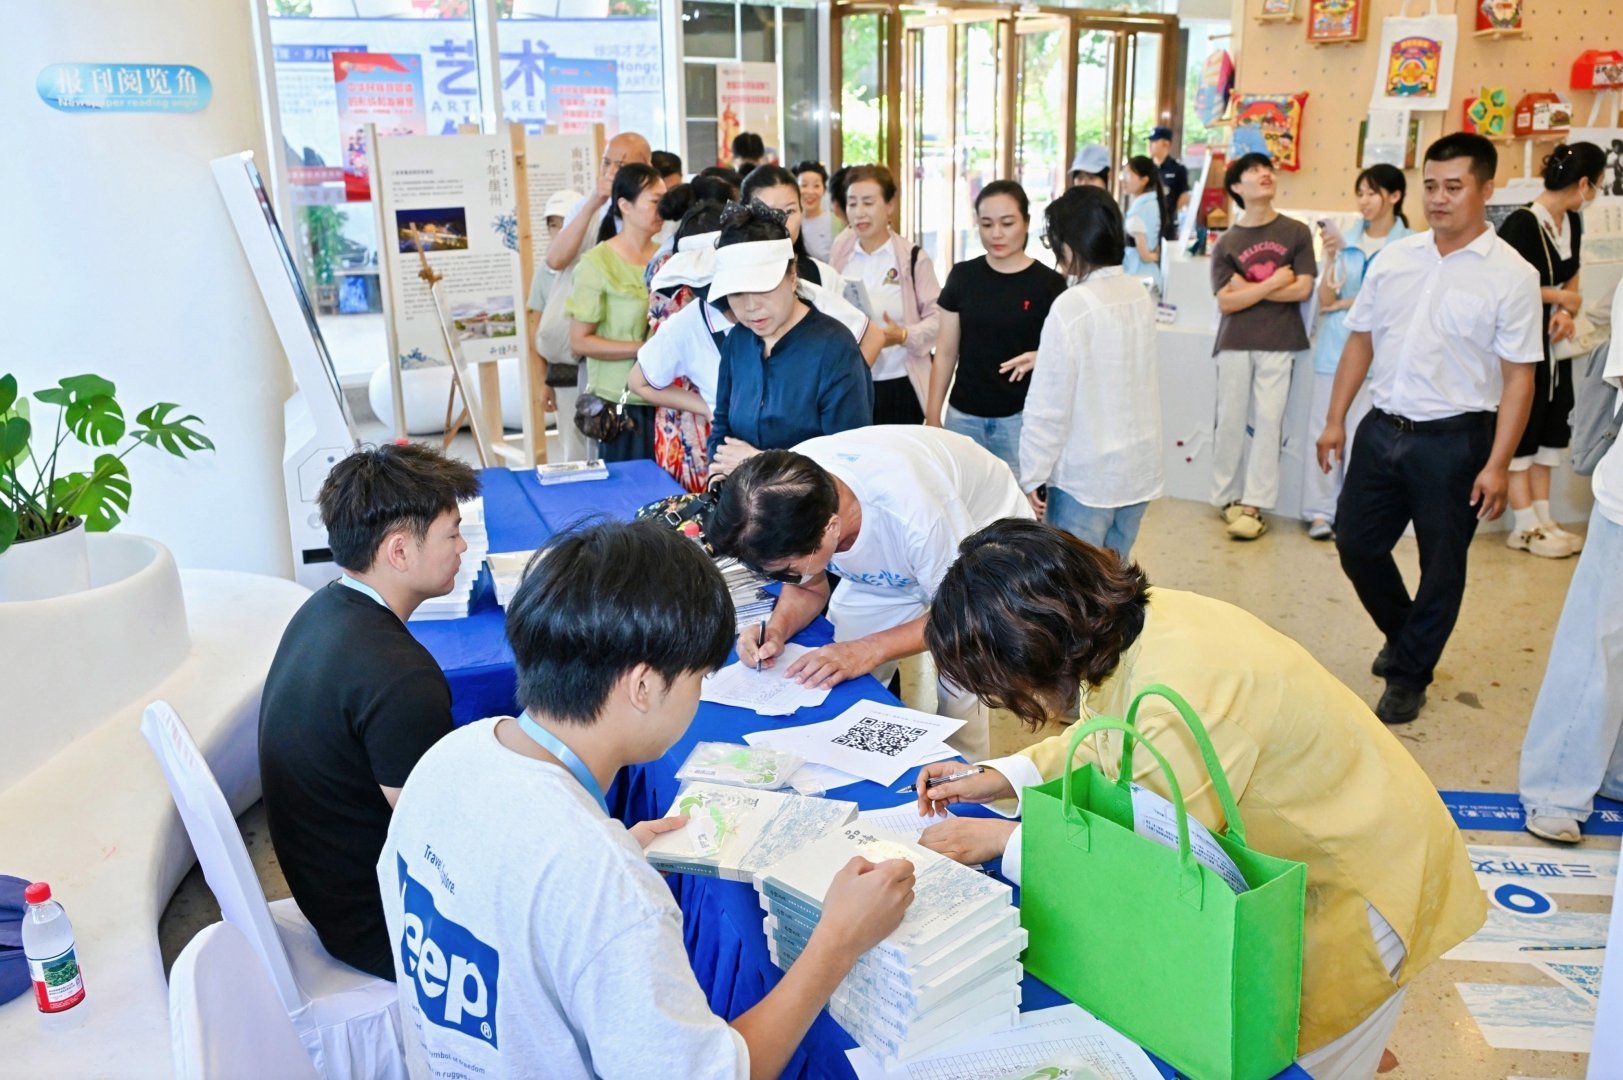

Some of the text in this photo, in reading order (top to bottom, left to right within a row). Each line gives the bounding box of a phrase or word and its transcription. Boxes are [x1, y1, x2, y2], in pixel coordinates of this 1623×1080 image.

[56, 67, 197, 95] 报刊阅览角
[1238, 241, 1288, 264] DELICIOUS
[402, 905, 489, 1026] eep
